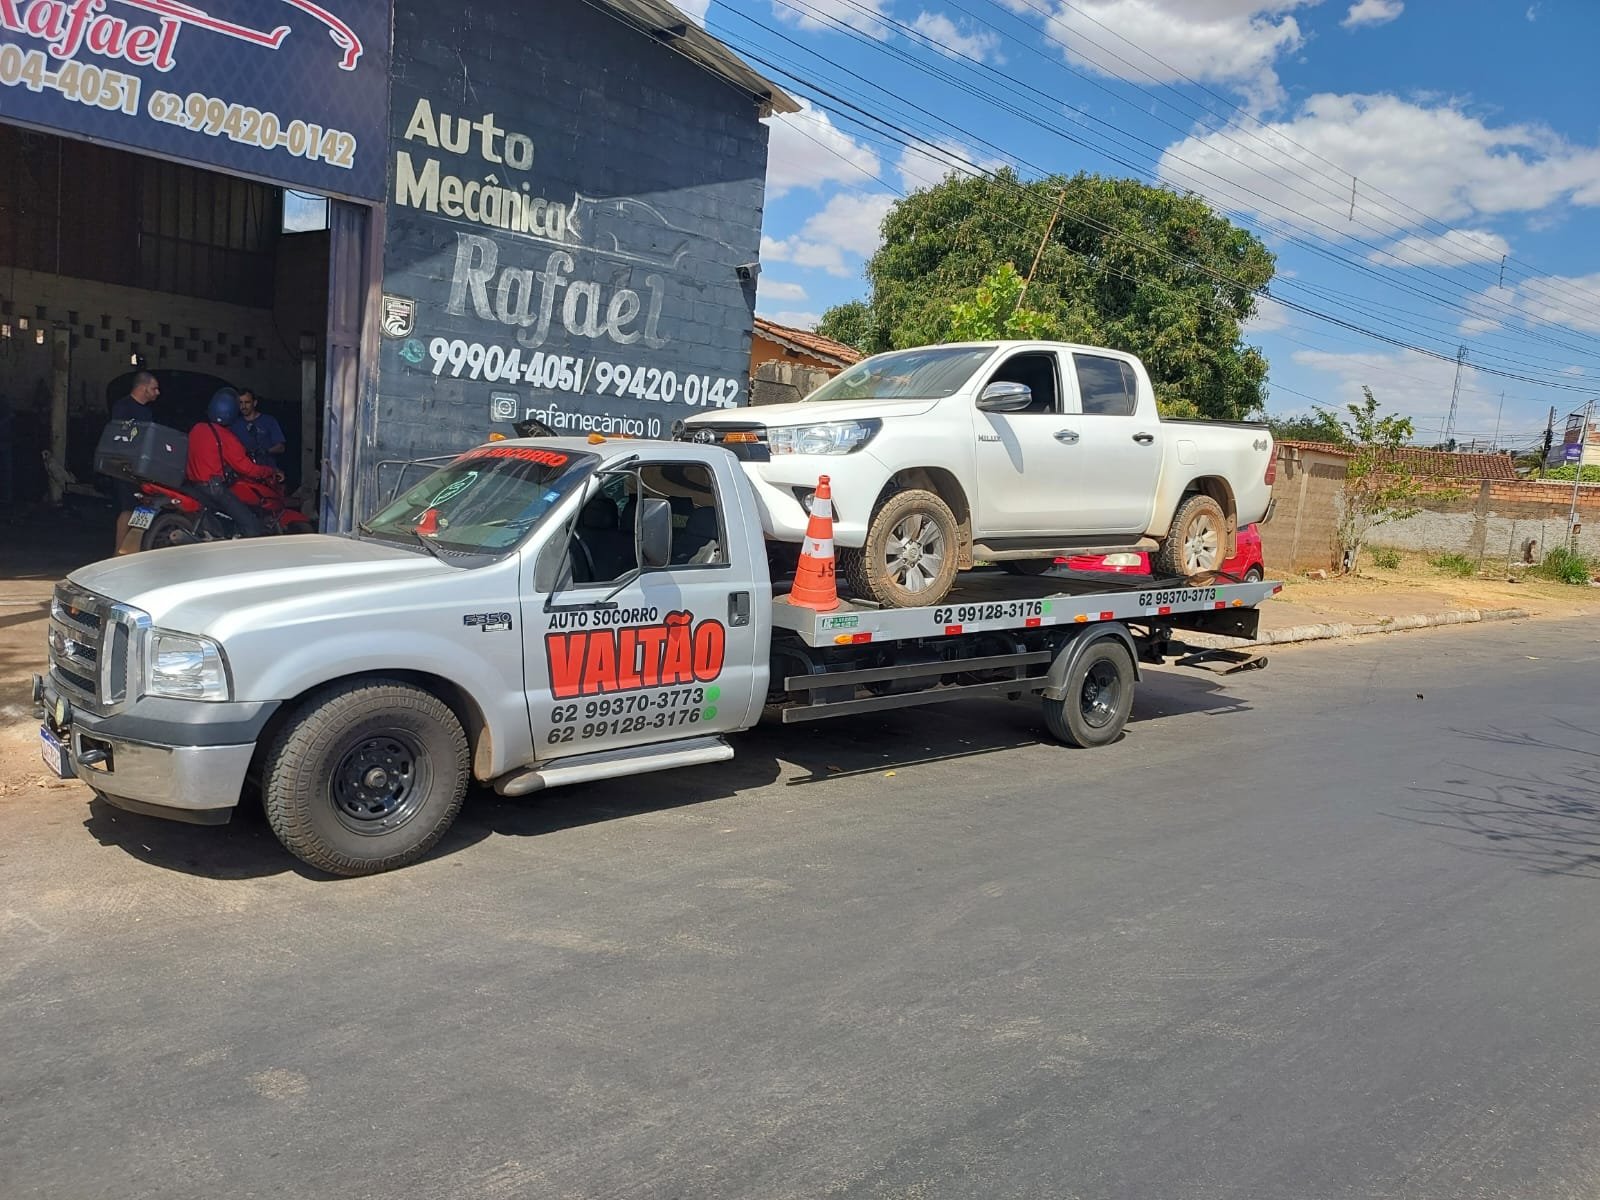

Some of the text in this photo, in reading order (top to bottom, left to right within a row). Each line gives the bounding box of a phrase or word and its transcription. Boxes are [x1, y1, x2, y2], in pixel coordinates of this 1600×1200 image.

[148, 91, 356, 168] 62.99420-0142
[404, 98, 534, 171] Auto
[395, 151, 567, 240] Mecânica
[446, 231, 671, 349] Rafael
[548, 607, 658, 629] AUTO SOCORRO
[934, 601, 1042, 624] 62 99128-3176
[1139, 588, 1216, 606] 62 99370-3773
[544, 610, 726, 700] VALTÃO
[547, 708, 700, 744] 62 99128-3176
[551, 688, 704, 723] 62 99370-3773
